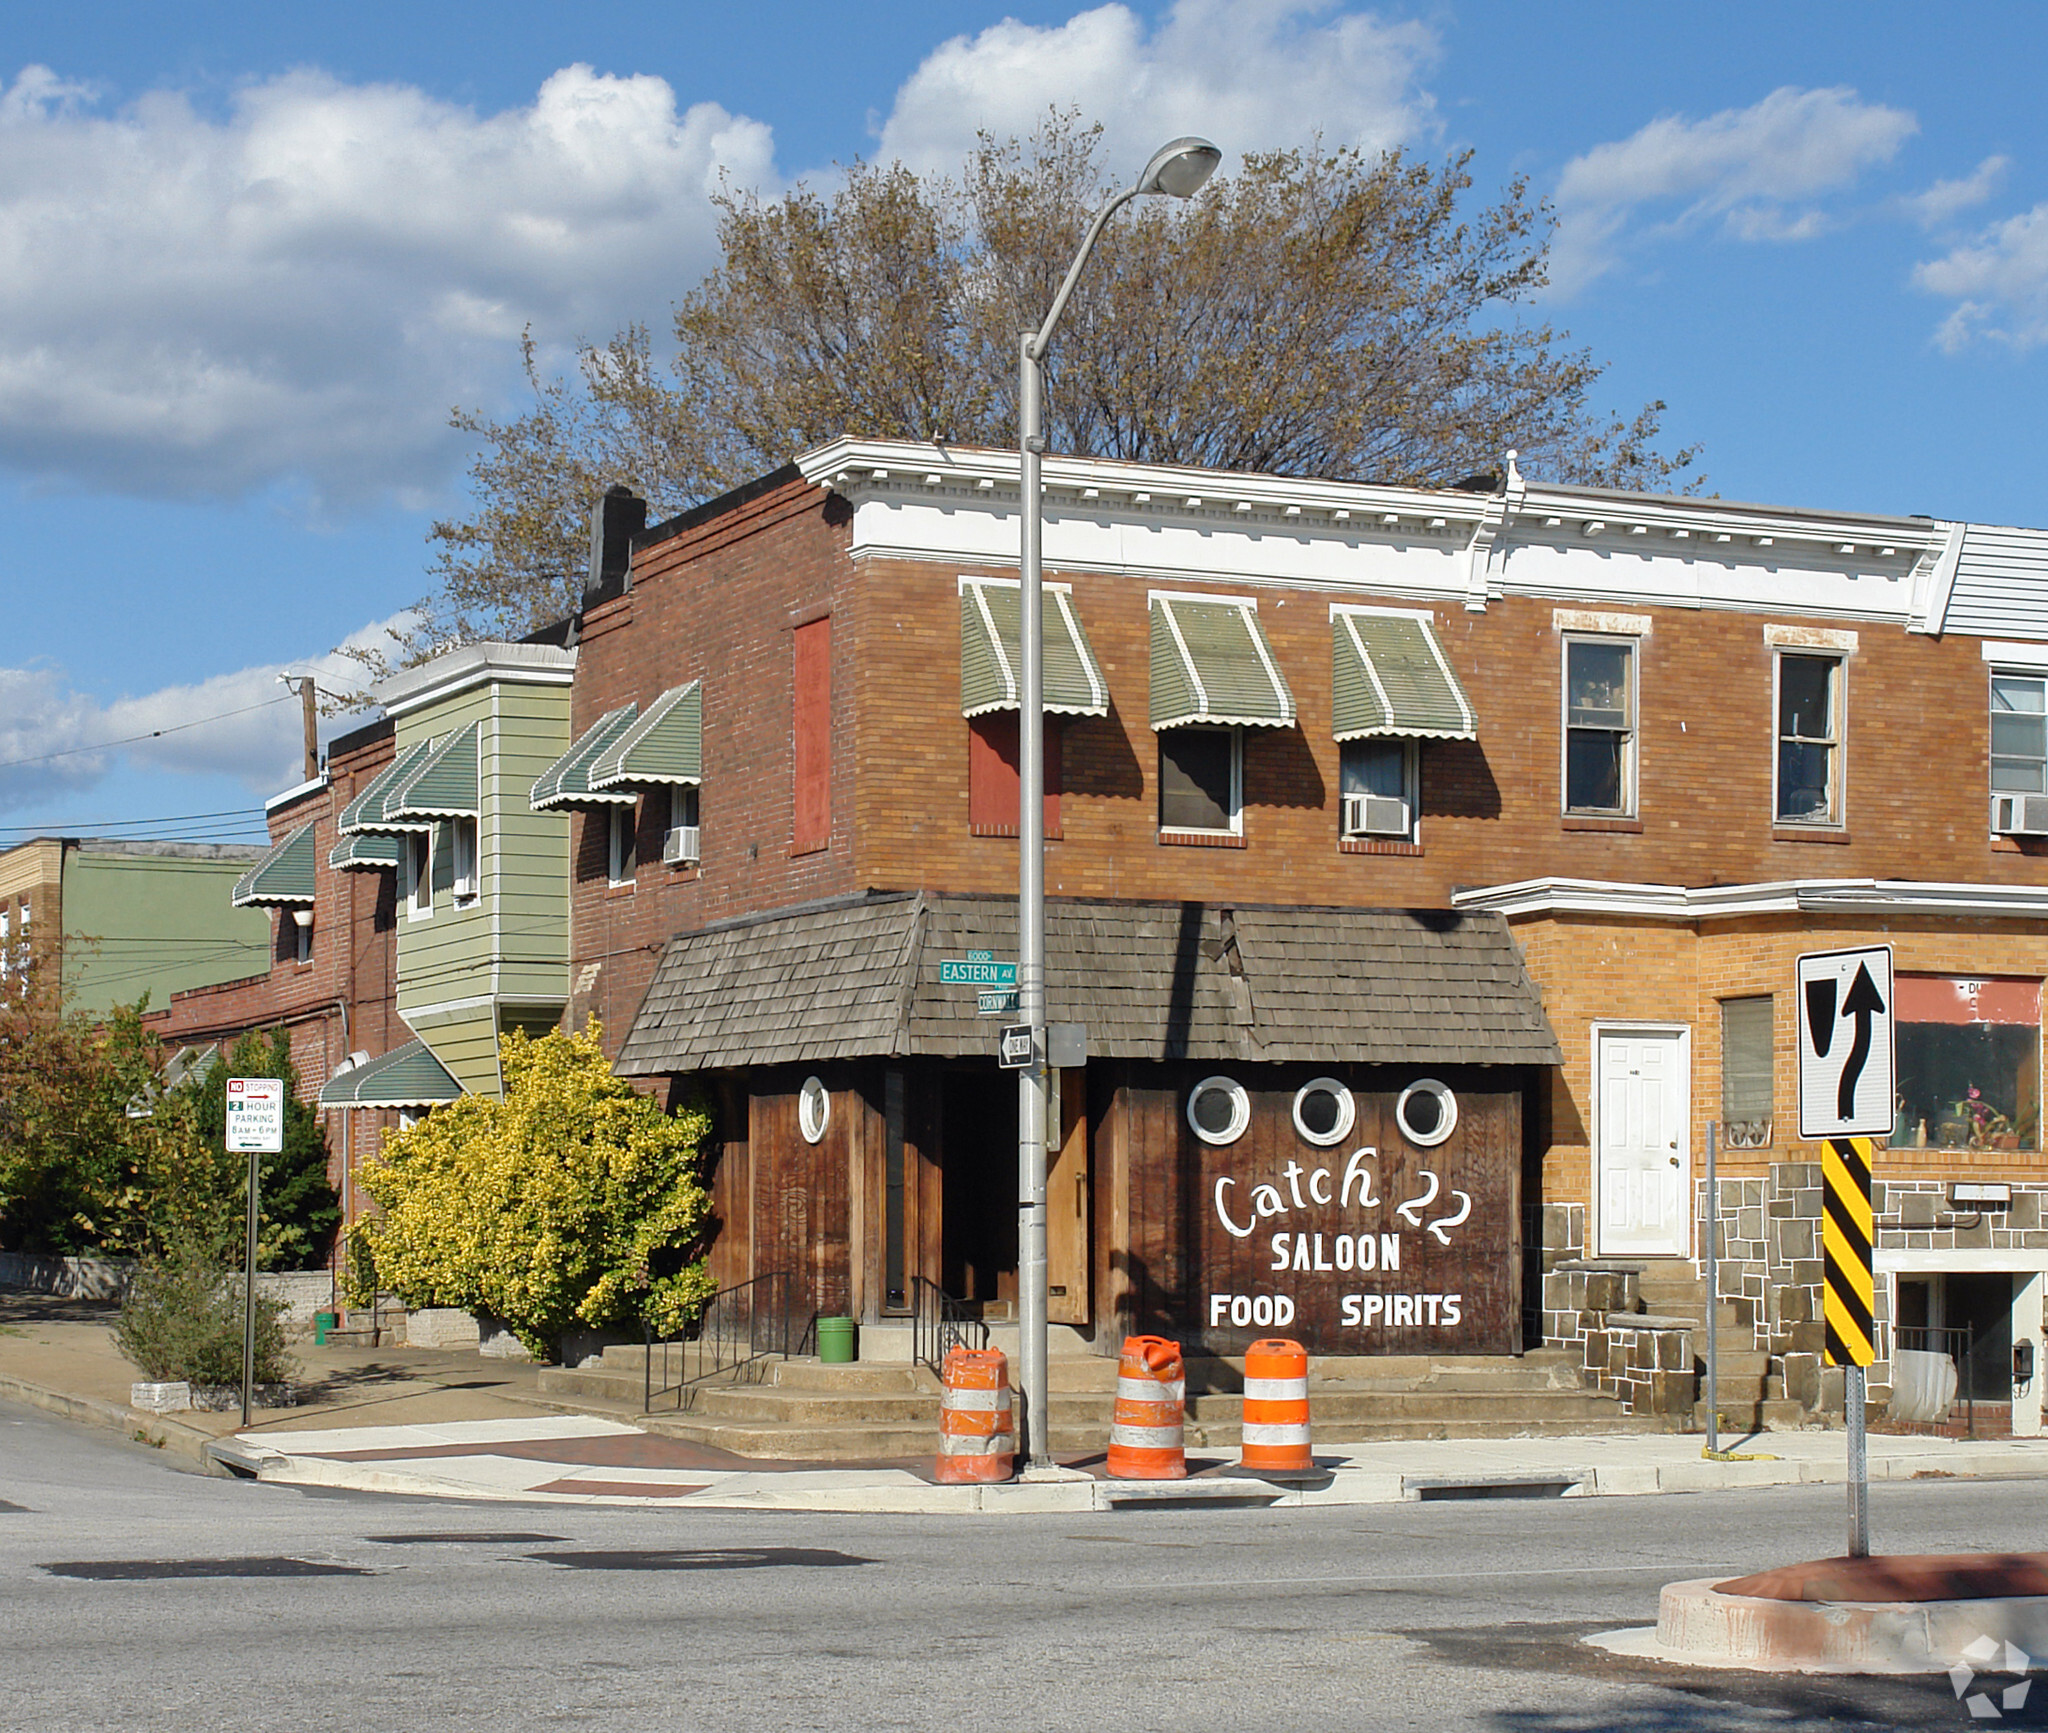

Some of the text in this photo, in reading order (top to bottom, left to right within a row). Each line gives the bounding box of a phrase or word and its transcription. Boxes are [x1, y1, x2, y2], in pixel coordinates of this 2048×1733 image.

[943, 964, 998, 981] EASTERN
[1009, 1036, 1029, 1054] ONE WAY
[231, 1082, 278, 1092] NO STOPPING
[232, 1102, 276, 1111] 2 HOUR
[235, 1115, 274, 1123] PARKING
[1214, 1147, 1472, 1246] Catch 22
[1271, 1233, 1400, 1271] SALOON
[1210, 1294, 1462, 1327] FOOD SPIRITS
